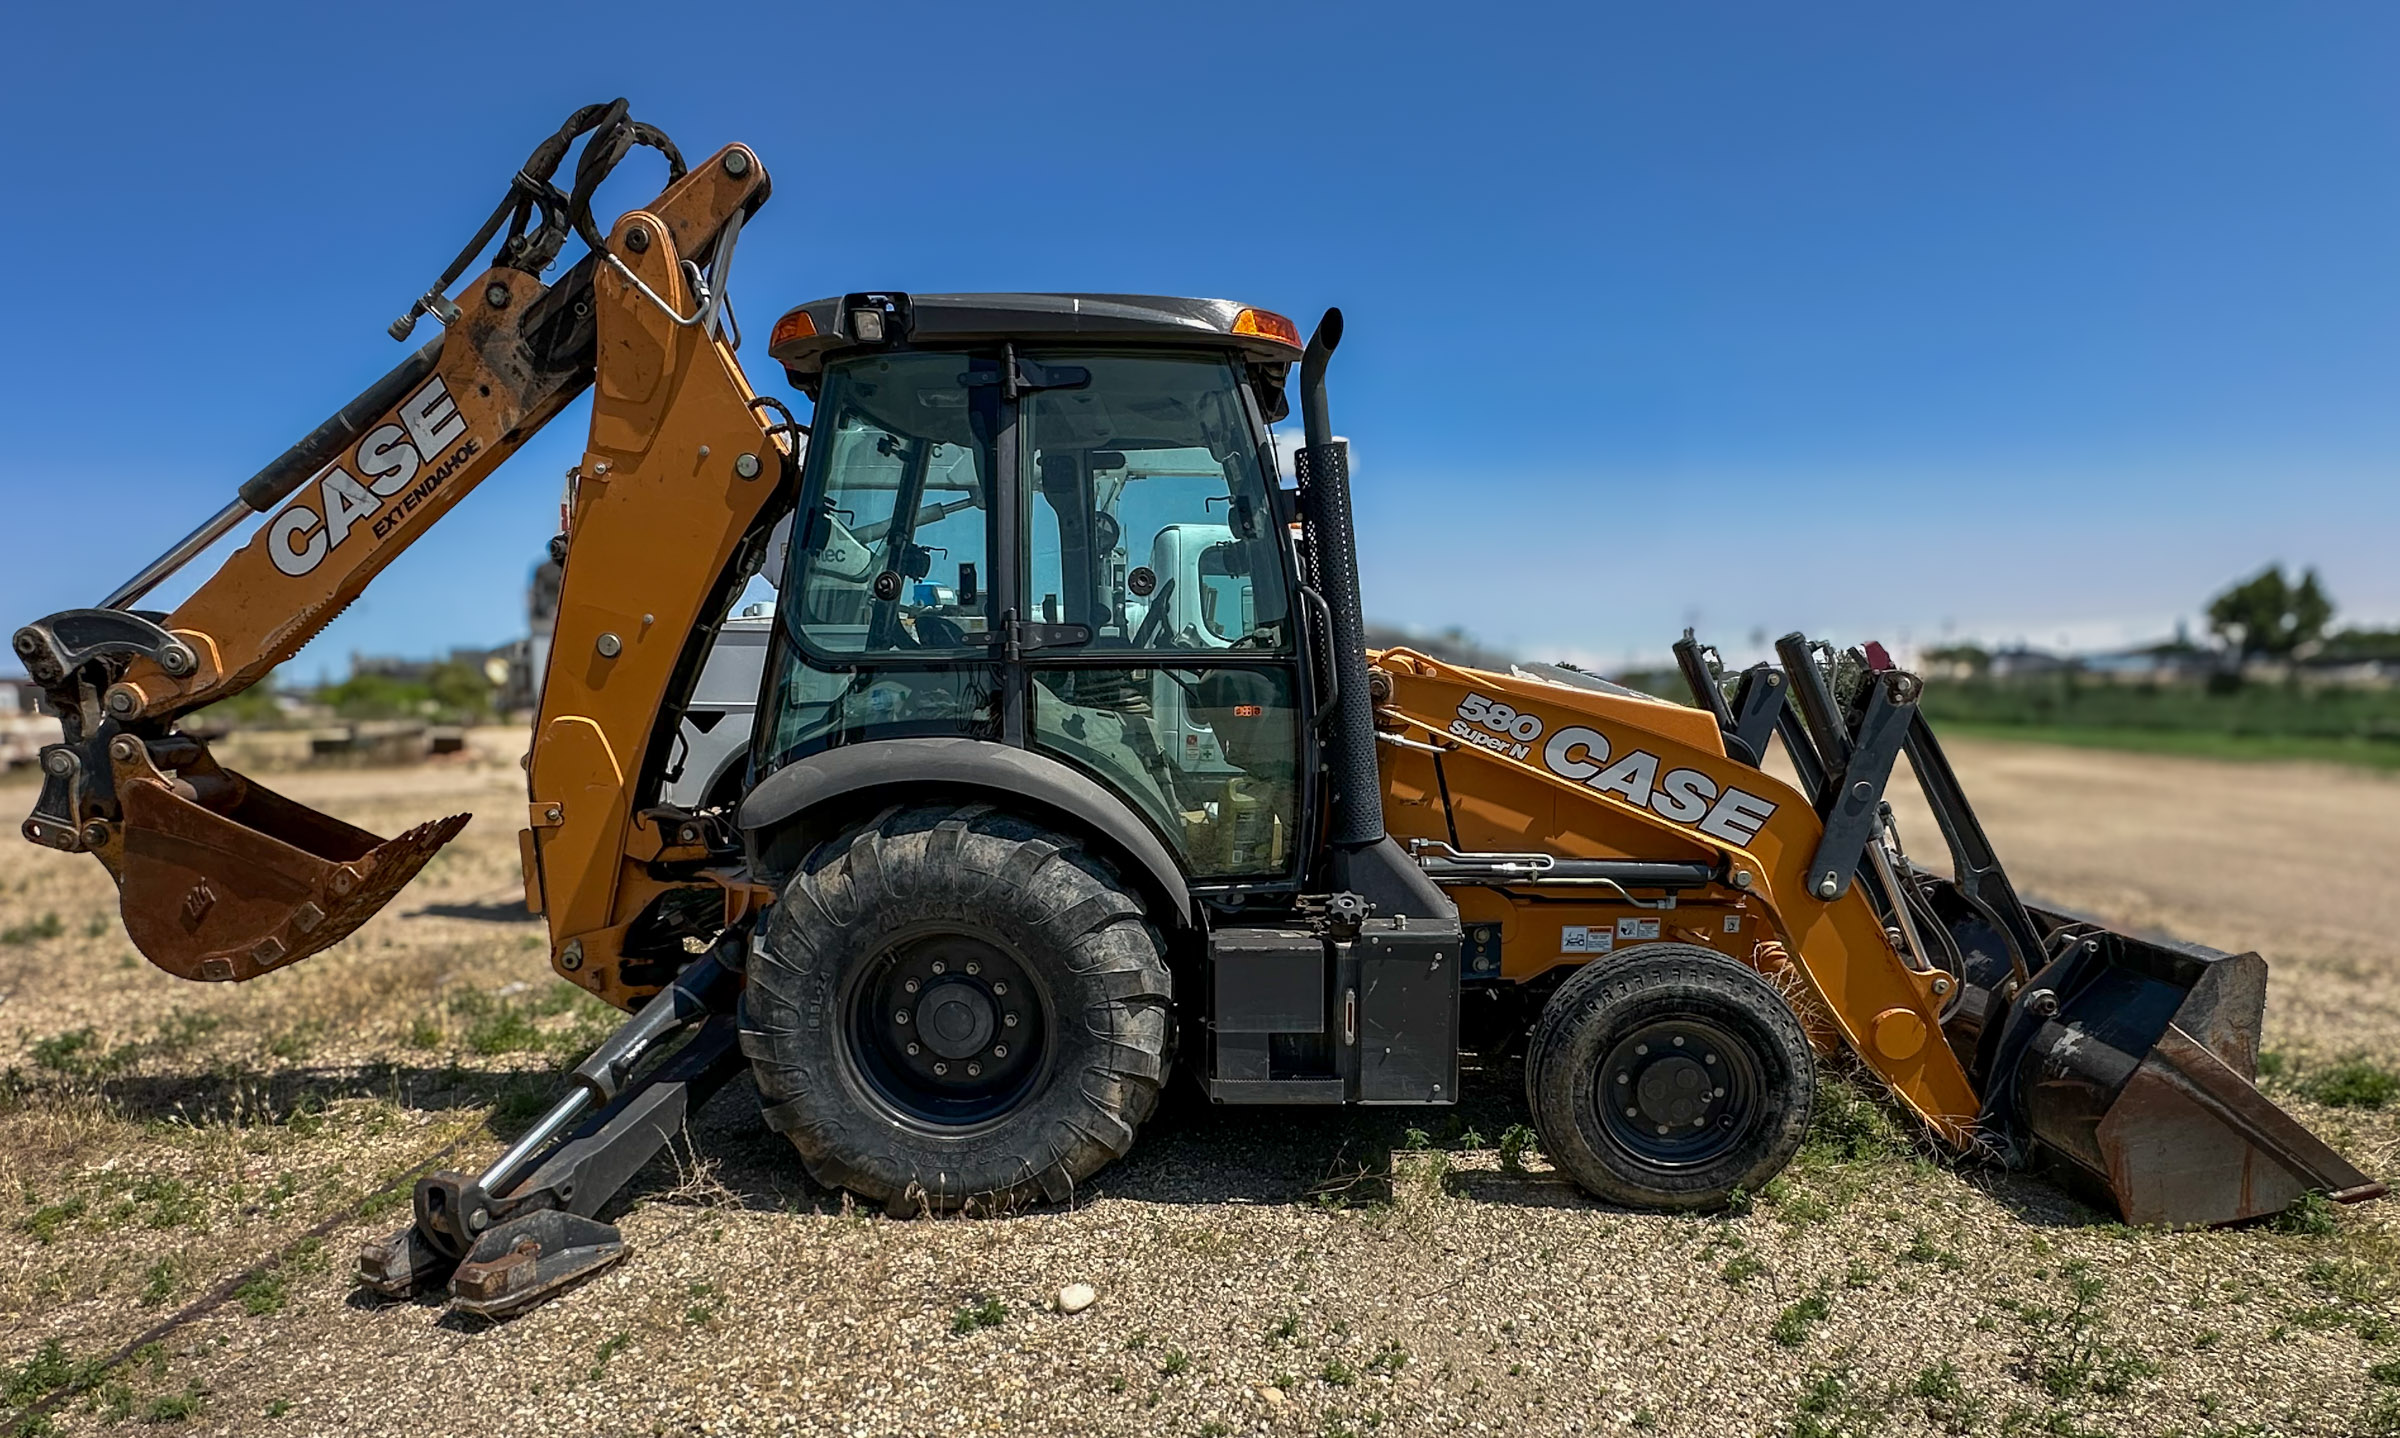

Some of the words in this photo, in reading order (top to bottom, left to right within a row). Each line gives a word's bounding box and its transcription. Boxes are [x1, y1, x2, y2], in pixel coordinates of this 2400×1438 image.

[267, 373, 469, 577] CASE
[371, 437, 481, 540] EXTENDAHOE
[1448, 718, 1512, 752] Super
[1508, 741, 1532, 760] N
[1456, 691, 1544, 742] 580
[1543, 725, 1779, 848] CASE
